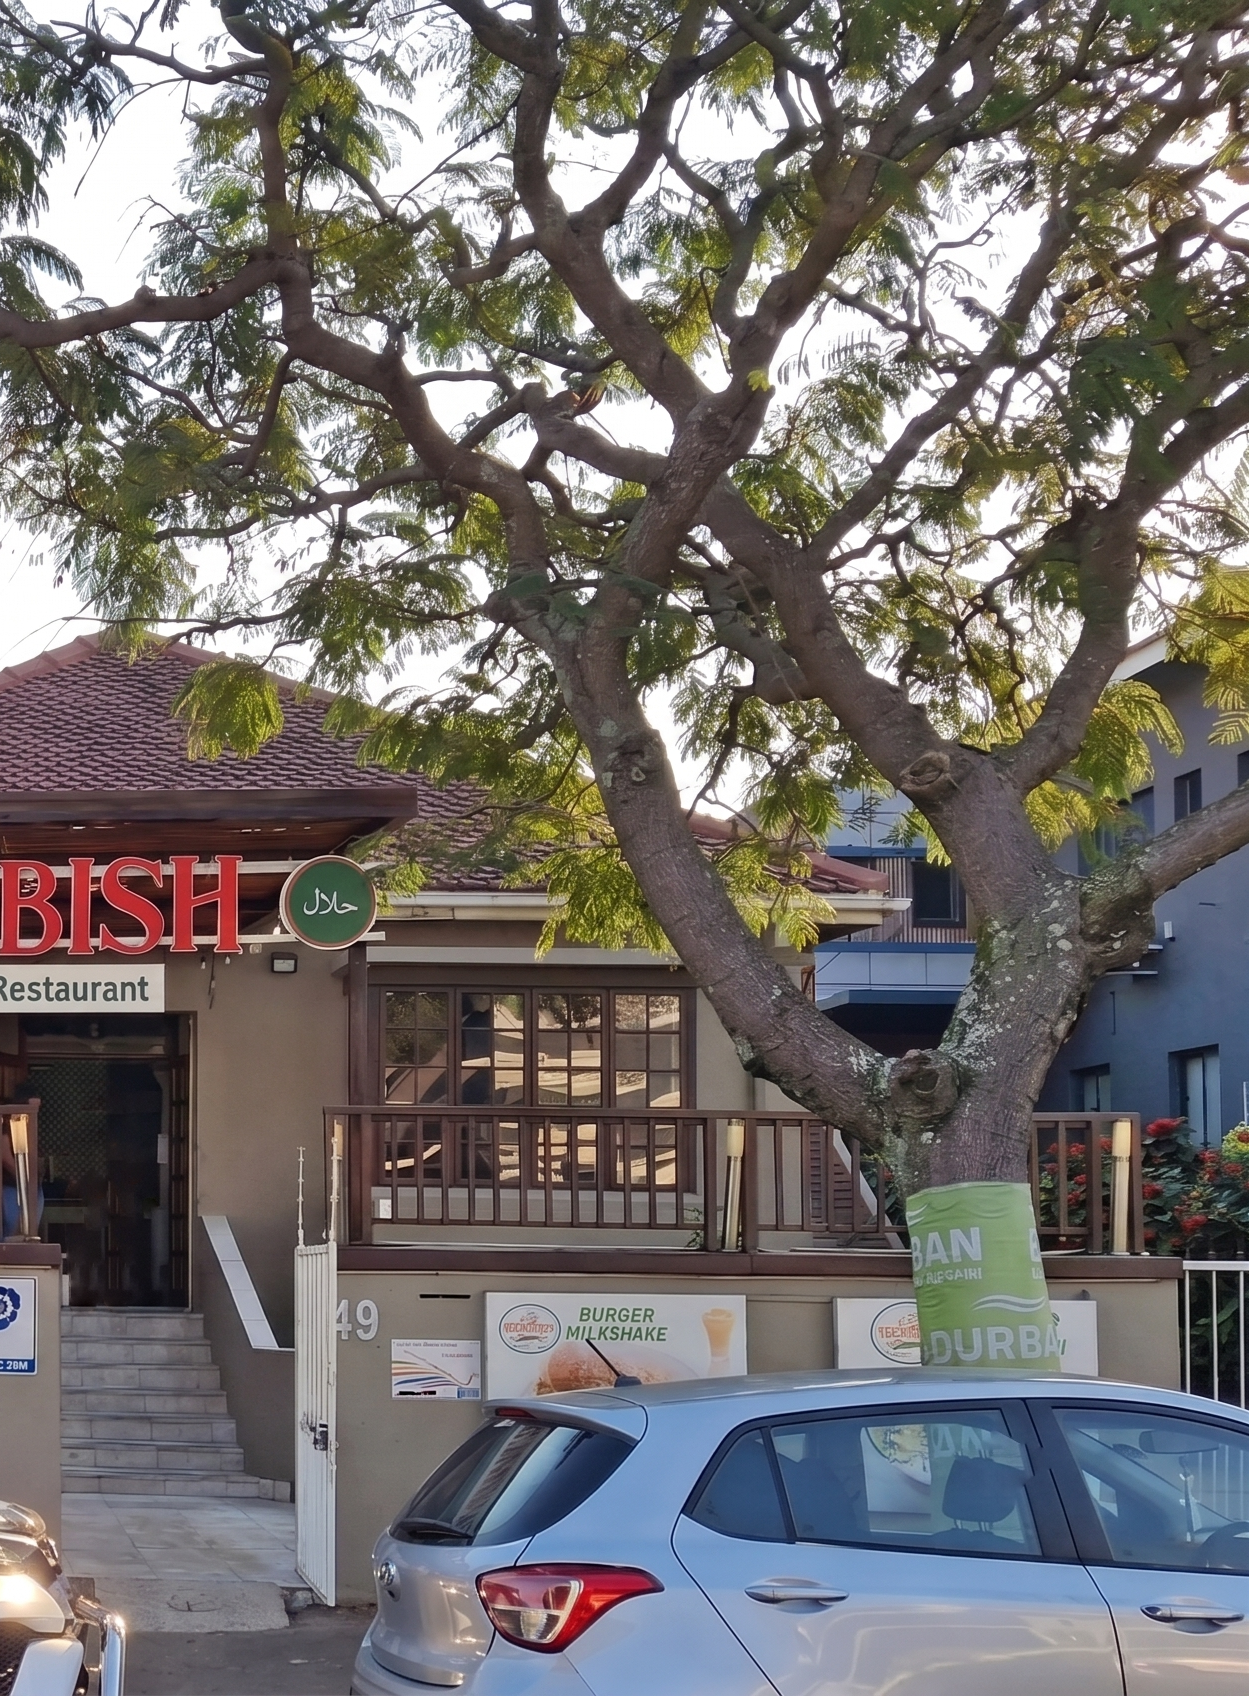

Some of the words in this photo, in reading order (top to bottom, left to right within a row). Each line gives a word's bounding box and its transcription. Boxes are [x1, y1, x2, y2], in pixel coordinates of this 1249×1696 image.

[303, 887, 359, 916] حلال
[578, 1306, 655, 1323] BURGER
[565, 1325, 669, 1342] MILKSHAKE
